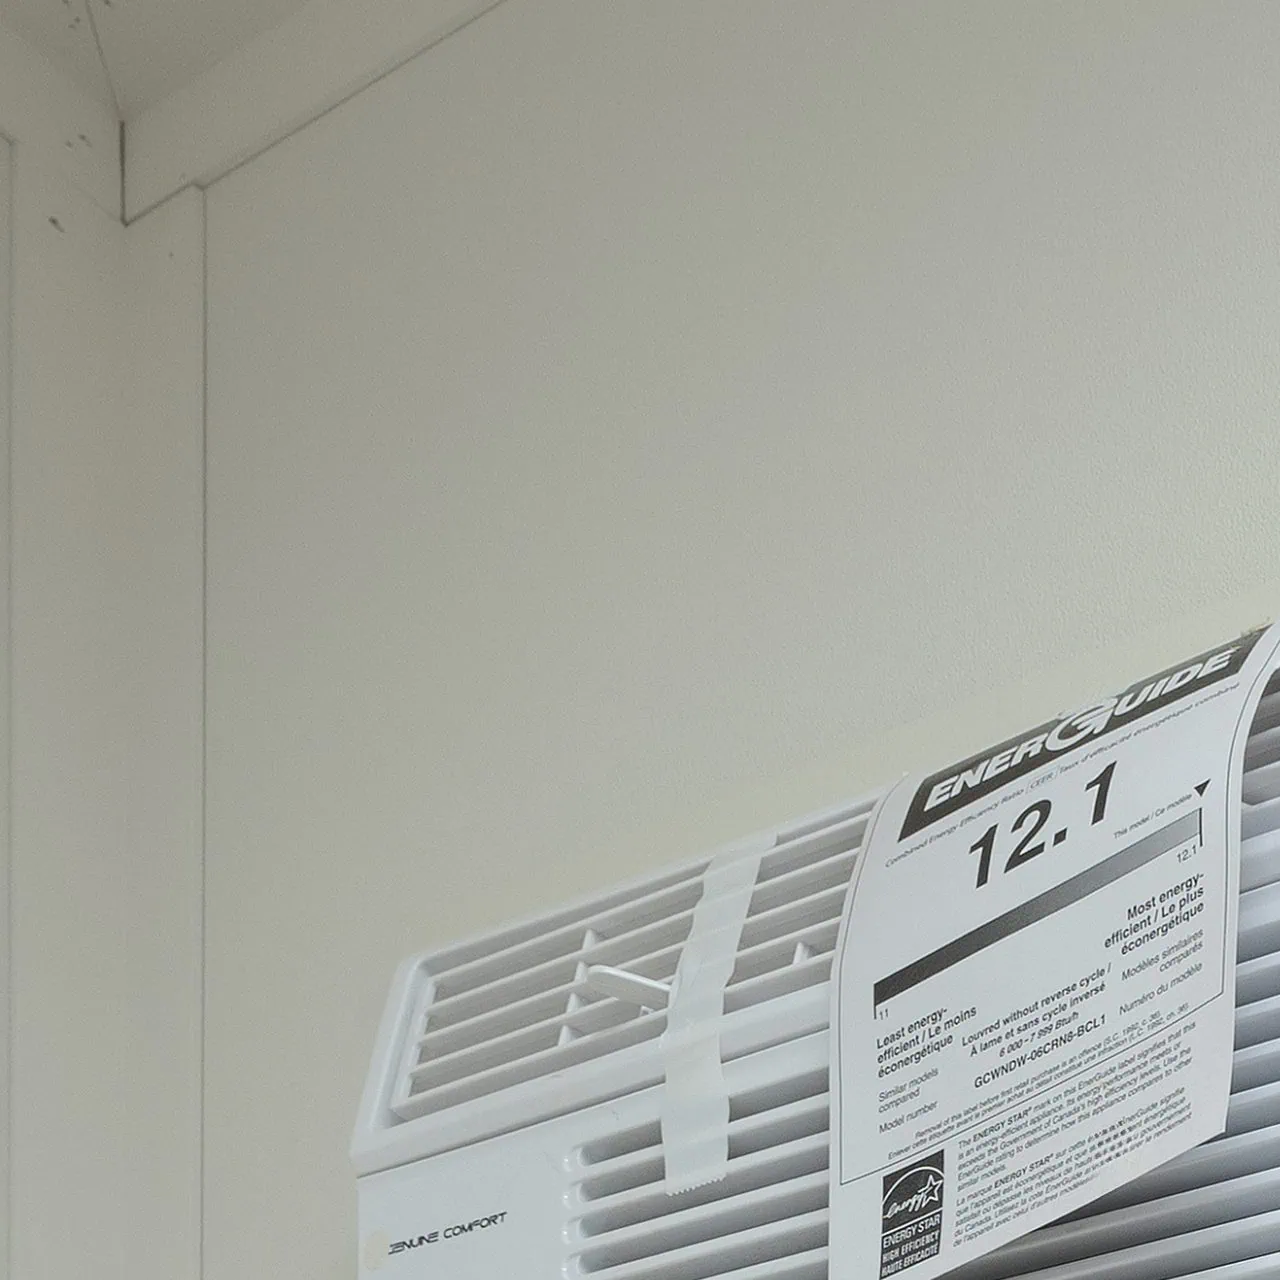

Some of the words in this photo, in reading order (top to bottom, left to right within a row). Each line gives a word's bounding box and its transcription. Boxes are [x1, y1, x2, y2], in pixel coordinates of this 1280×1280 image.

[1177, 845, 1197, 863] 12.1
[1127, 897, 1155, 920] Most
[1159, 874, 1204, 903] energy-
[1104, 915, 1150, 948] efficient
[1161, 904, 1175, 918] Le
[1179, 888, 1203, 911] plus
[1121, 903, 1204, 955] éconergétique
[961, 1019, 1000, 1046] Louvred
[1002, 1001, 1038, 1025] without
[1041, 984, 1076, 1007] reverse
[1079, 969, 1105, 987] cycle
[1156, 983, 1168, 995] du
[876, 1027, 905, 1049] Least
[907, 1008, 947, 1033] energy-
[879, 1009, 888, 1020] 11
[980, 1036, 1001, 1052] lame
[1005, 1028, 1014, 1039] et
[1016, 1018, 1039, 1034] sans
[1042, 1004, 1067, 1021] cycle
[1070, 981, 1105, 1007] inversé
[877, 1035, 919, 1063] efficient
[928, 1026, 941, 1038] Le
[944, 1007, 976, 1030] moins
[878, 1035, 952, 1078] éconergétique
[878, 1087, 920, 1113] compared
[879, 1084, 907, 1102] Similar
[908, 1068, 938, 1088] models
[973, 1120, 1005, 1142] ENERGY
[1033, 1099, 1051, 1112] mark
[1052, 1094, 1061, 1103] on
[1063, 1087, 1076, 1097] this
[1118, 1055, 1135, 1069] label
[879, 1115, 904, 1133] Model
[906, 1101, 937, 1121] number
[956, 1198, 964, 1206] La
[994, 1167, 1027, 1188] ENERGY
[443, 1211, 507, 1239] COMFORT
[883, 1225, 917, 1248] ENERGY
[918, 1214, 940, 1233] STAR
